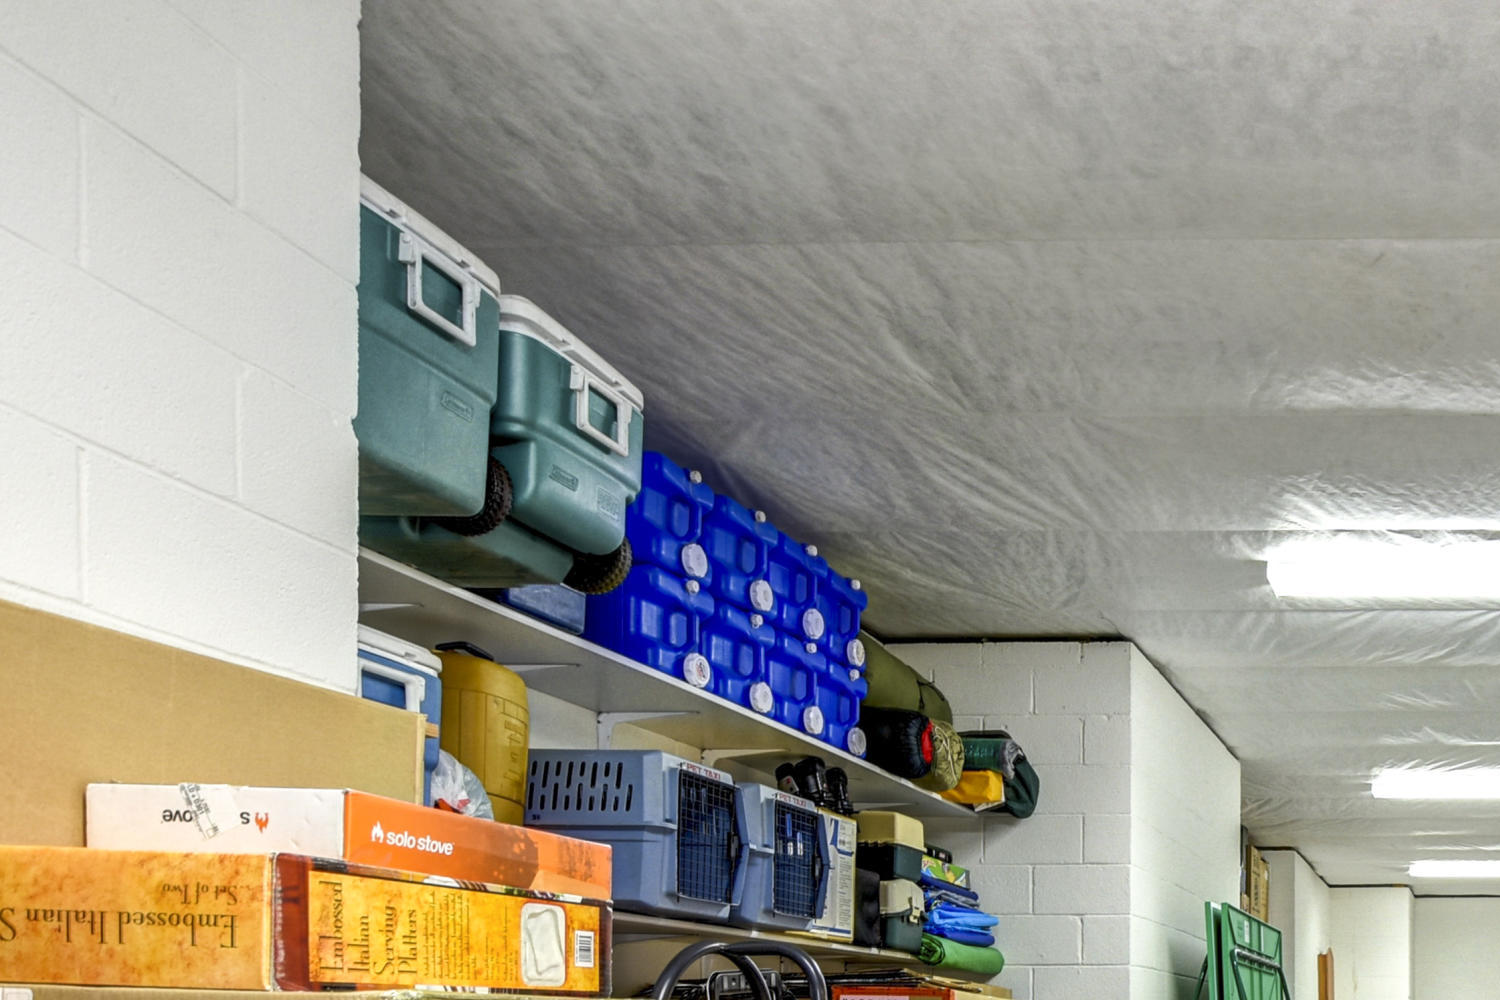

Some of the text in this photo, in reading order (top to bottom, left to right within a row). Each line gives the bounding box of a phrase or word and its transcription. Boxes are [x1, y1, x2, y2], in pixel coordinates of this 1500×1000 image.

[386, 831, 453, 856] solo stove
[162, 883, 190, 904] Two
[195, 880, 209, 903] of
[26, 908, 107, 944] Italian
[117, 910, 239, 949] Embossed
[319, 881, 344, 974] Embossed
[347, 915, 370, 974] Italian
[372, 904, 398, 976] Serving
[398, 909, 418, 975] Platters
